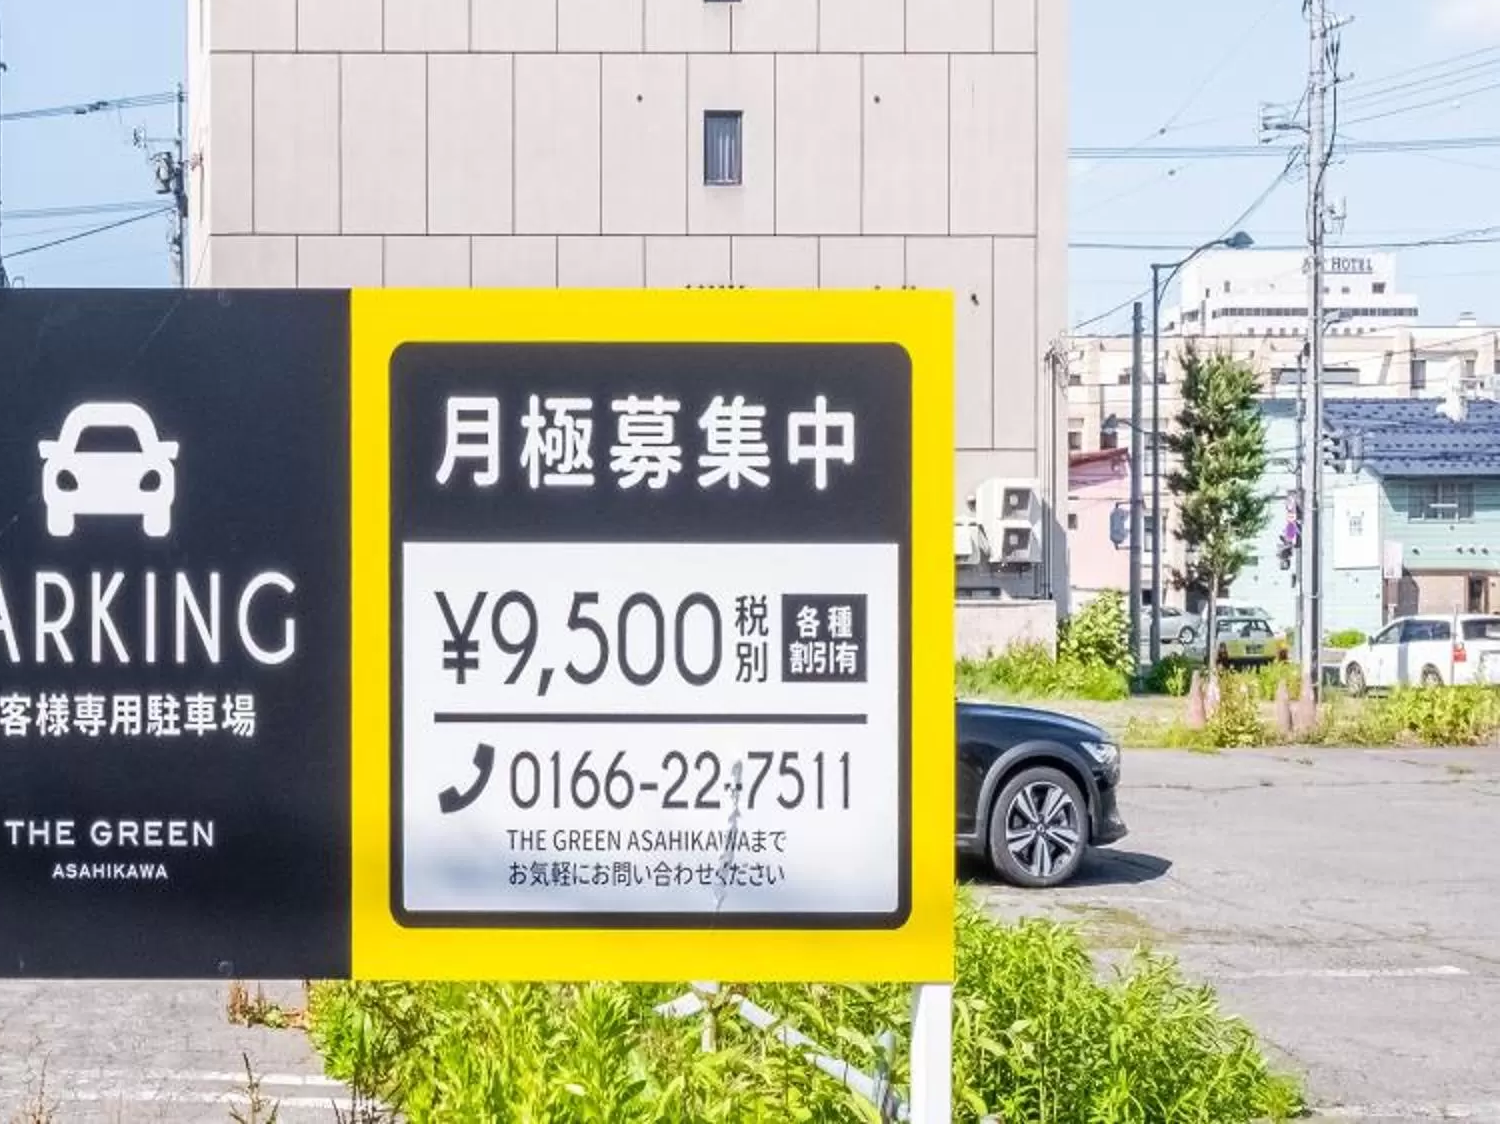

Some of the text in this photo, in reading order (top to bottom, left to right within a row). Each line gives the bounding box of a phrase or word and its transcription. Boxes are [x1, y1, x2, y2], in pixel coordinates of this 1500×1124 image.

[1330, 256, 1373, 272] HOTEL
[436, 394, 855, 491] 月極募集中
[734, 594, 769, 683] 税別
[795, 605, 853, 639] 各種
[433, 589, 723, 696] ¥9,500
[789, 640, 859, 675] 割引有
[509, 750, 851, 810] 0166-22-7511
[4, 820, 214, 847] THE GREEN
[507, 829, 547, 852] THE
[553, 829, 621, 852] GREEN
[51, 863, 169, 879] ASAHIKAWA
[508, 860, 786, 887] お気軽にお問い合わせください
